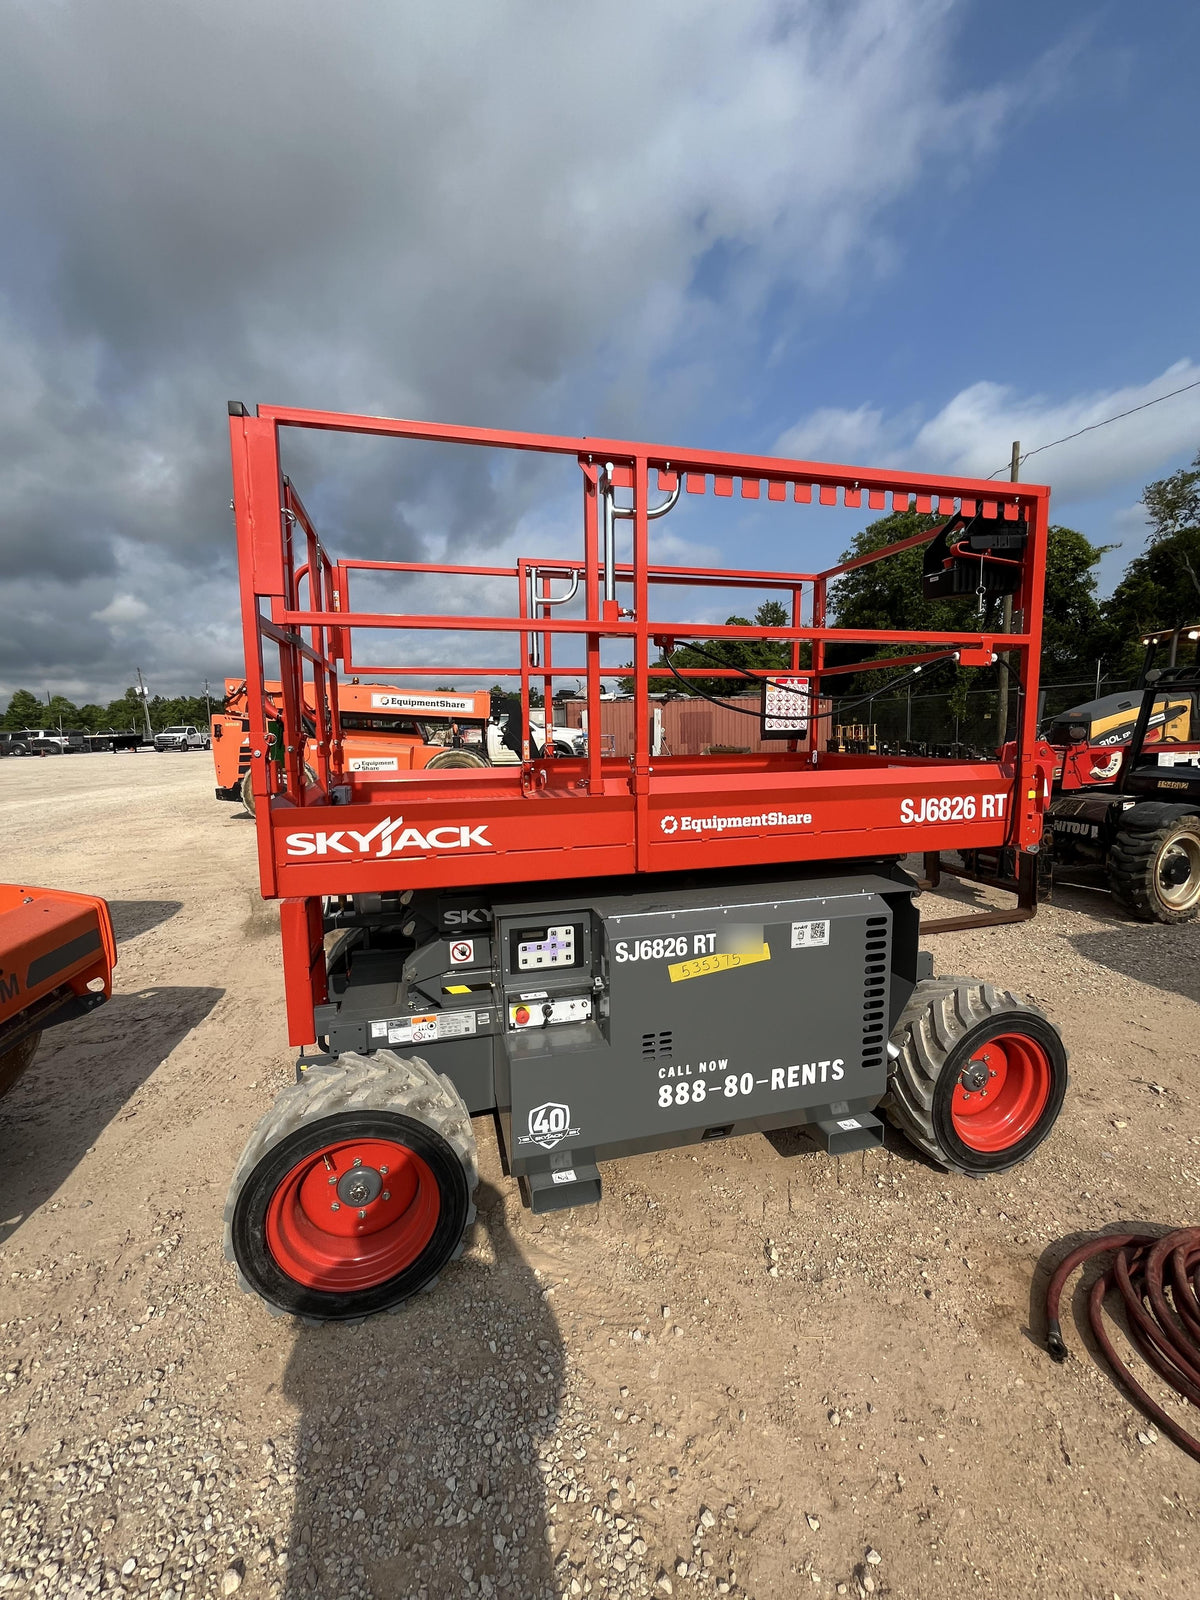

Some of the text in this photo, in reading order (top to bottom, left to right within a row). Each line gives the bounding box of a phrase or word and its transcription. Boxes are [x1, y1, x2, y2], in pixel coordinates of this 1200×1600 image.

[391, 697, 466, 709] EquipmentShare
[900, 793, 1007, 824] SJ6826 RT
[680, 811, 812, 833] EquipmentShare
[286, 816, 493, 858] SKYJACK
[615, 933, 717, 963] SJ6826 RT
[681, 953, 741, 978] 535375
[658, 1058, 728, 1079] CALL NOW
[533, 1108, 565, 1134] 40
[534, 1132, 564, 1141] SKYJACK
